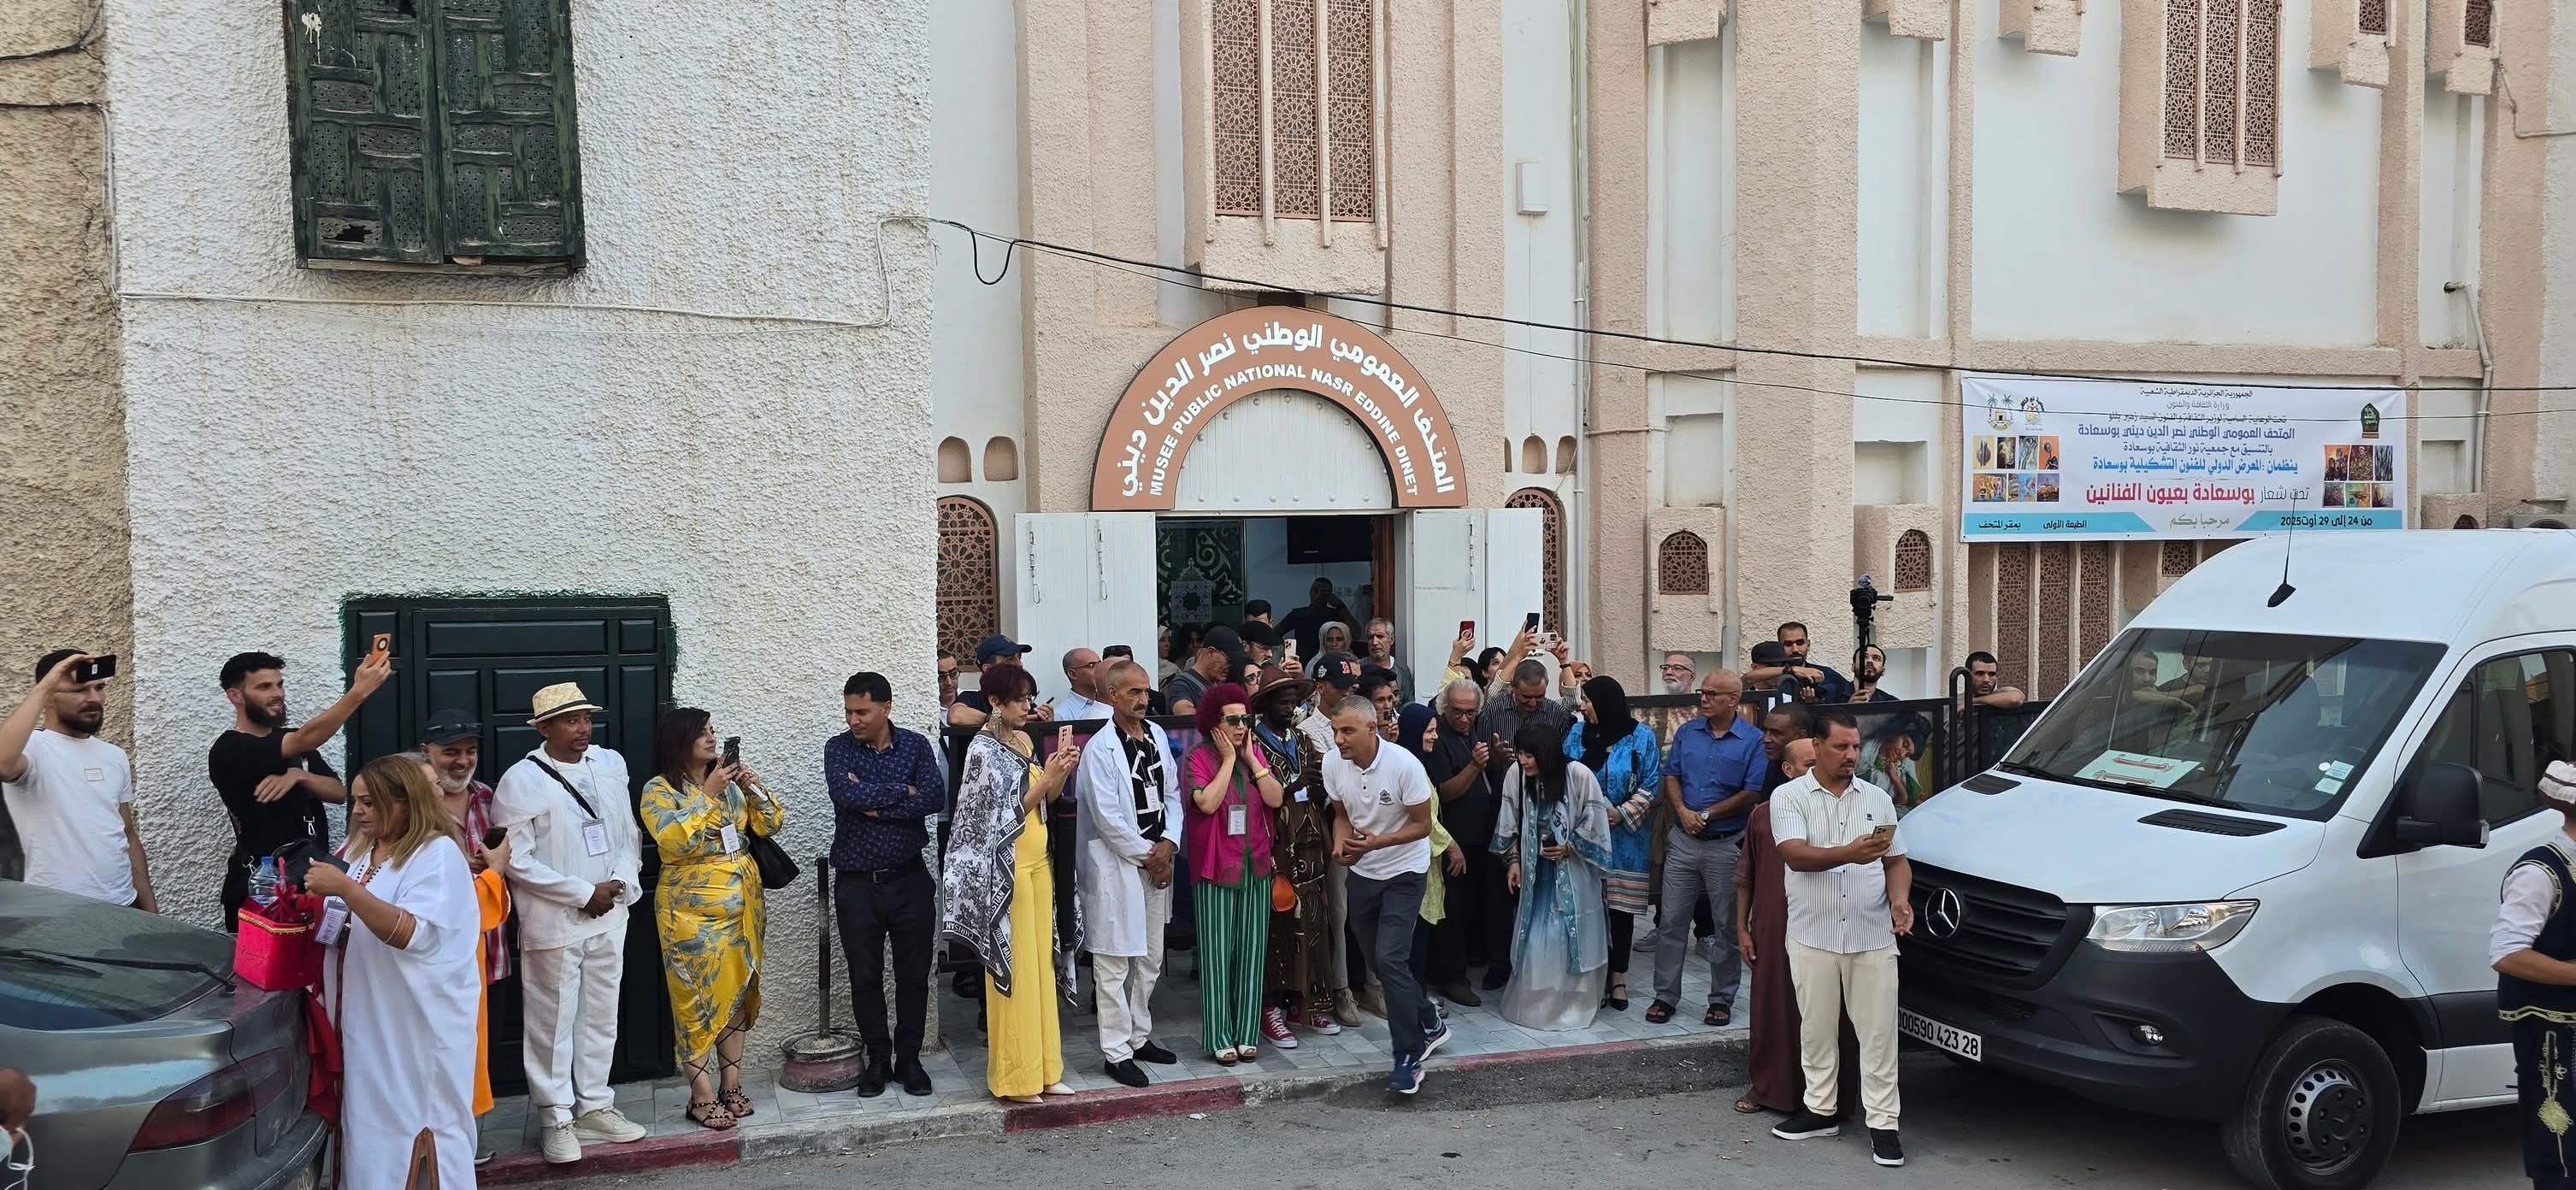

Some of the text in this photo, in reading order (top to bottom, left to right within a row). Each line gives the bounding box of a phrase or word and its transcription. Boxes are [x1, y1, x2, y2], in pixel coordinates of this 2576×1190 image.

[2141, 386, 2253, 399] الجمهورية الجزائرية الديمقراطية الشعبية
[1117, 321, 1455, 497] المتحف العمومي الوطني نصر الدين ديني
[2167, 400, 2230, 410] وزارة الثقافة والفنون
[1150, 363, 1418, 496] MUSEE PUBLIC NATIONAL NASR EDDINE DINET
[2078, 423, 2296, 439] المتحف العمومي الوطني نصر الدين ديني بوسعادة
[2124, 441, 2273, 458] بالتنسيق مع جمعية نور الثقافية بوسعادة
[2093, 456, 2127, 473] بوسعادة
[2129, 456, 2178, 473] التشكيلية
[2179, 457, 2206, 474] للفنون
[2208, 457, 2233, 475] الدولي
[2267, 459, 2298, 474] ينظمان
[2086, 482, 2309, 505] تحت شعار بوسعادة بعيون الفنانين
[1978, 520, 2021, 529] بمقر المتحف
[2043, 520, 2087, 529] الطبعة الأولى
[2170, 512, 2230, 529] مرحبا بكم
[2319, 515, 2329, 525] 29
[2331, 515, 2346, 527] إلى
[2348, 515, 2359, 525] 24
[2361, 515, 2373, 526] من
[1003, 820, 1019, 834] DIOR
[990, 890, 1005, 915] ISTIAN
[1936, 1025, 1959, 1050] 423
[1961, 1035, 1978, 1057] 28
